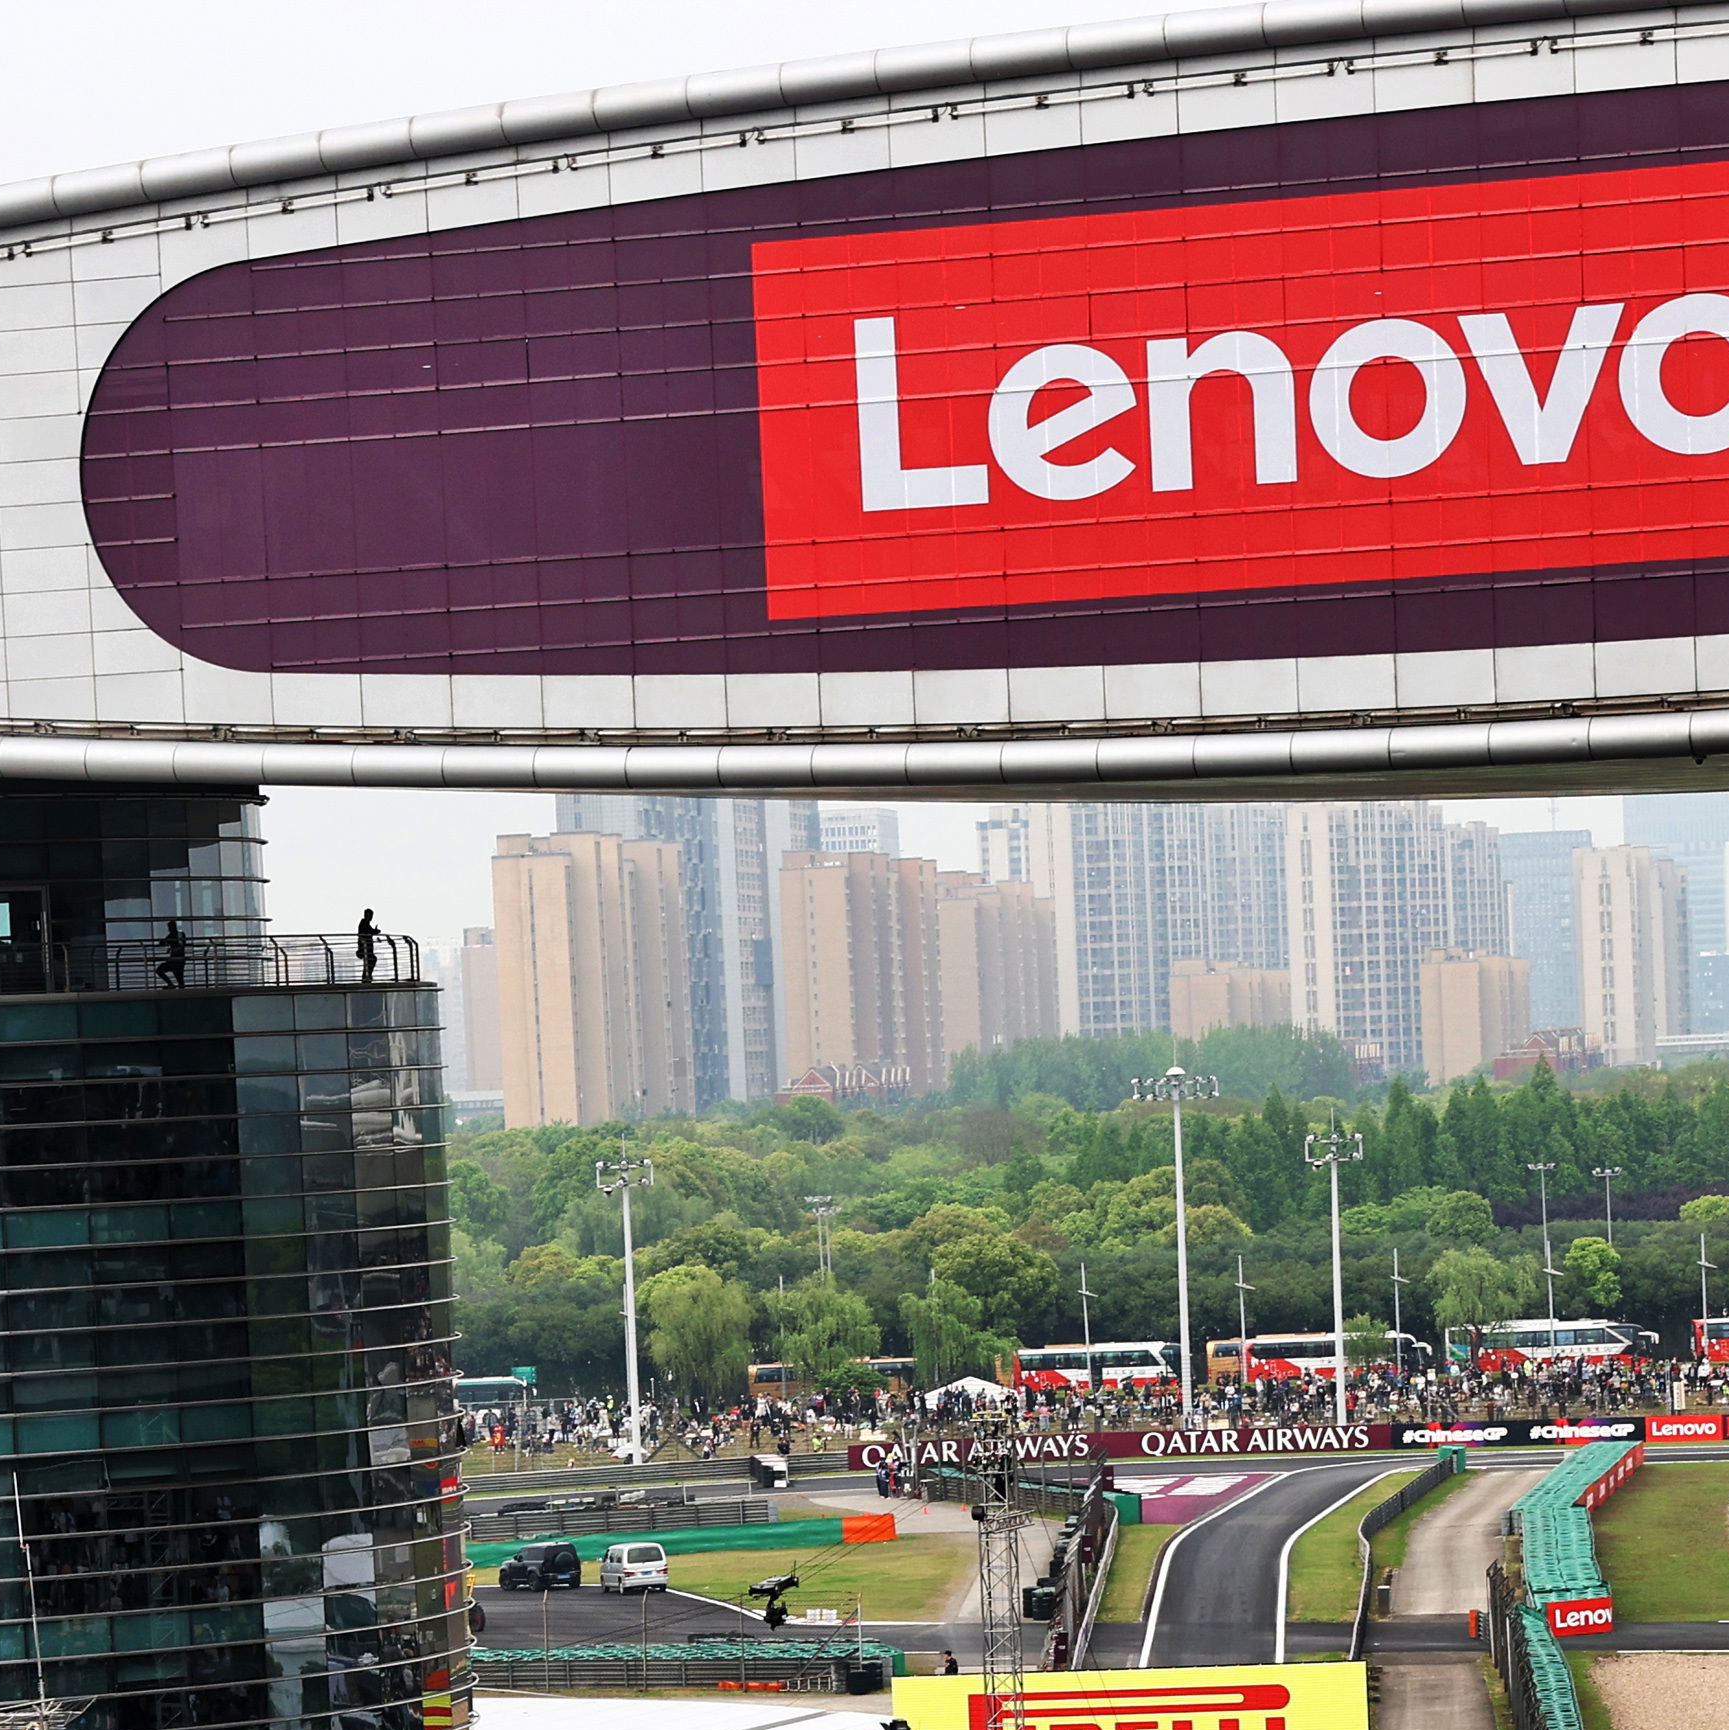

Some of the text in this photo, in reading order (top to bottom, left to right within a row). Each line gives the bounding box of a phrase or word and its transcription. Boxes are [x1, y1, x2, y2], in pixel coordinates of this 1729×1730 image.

[1402, 1425, 1508, 1445] #ChineseGP
[1529, 1422, 1636, 1440] #ChineseGP
[1651, 1420, 1717, 1437] Lenovo
[967, 1434, 1089, 1463] AWAYS
[1141, 1425, 1370, 1457] QATAR AIRWAYS
